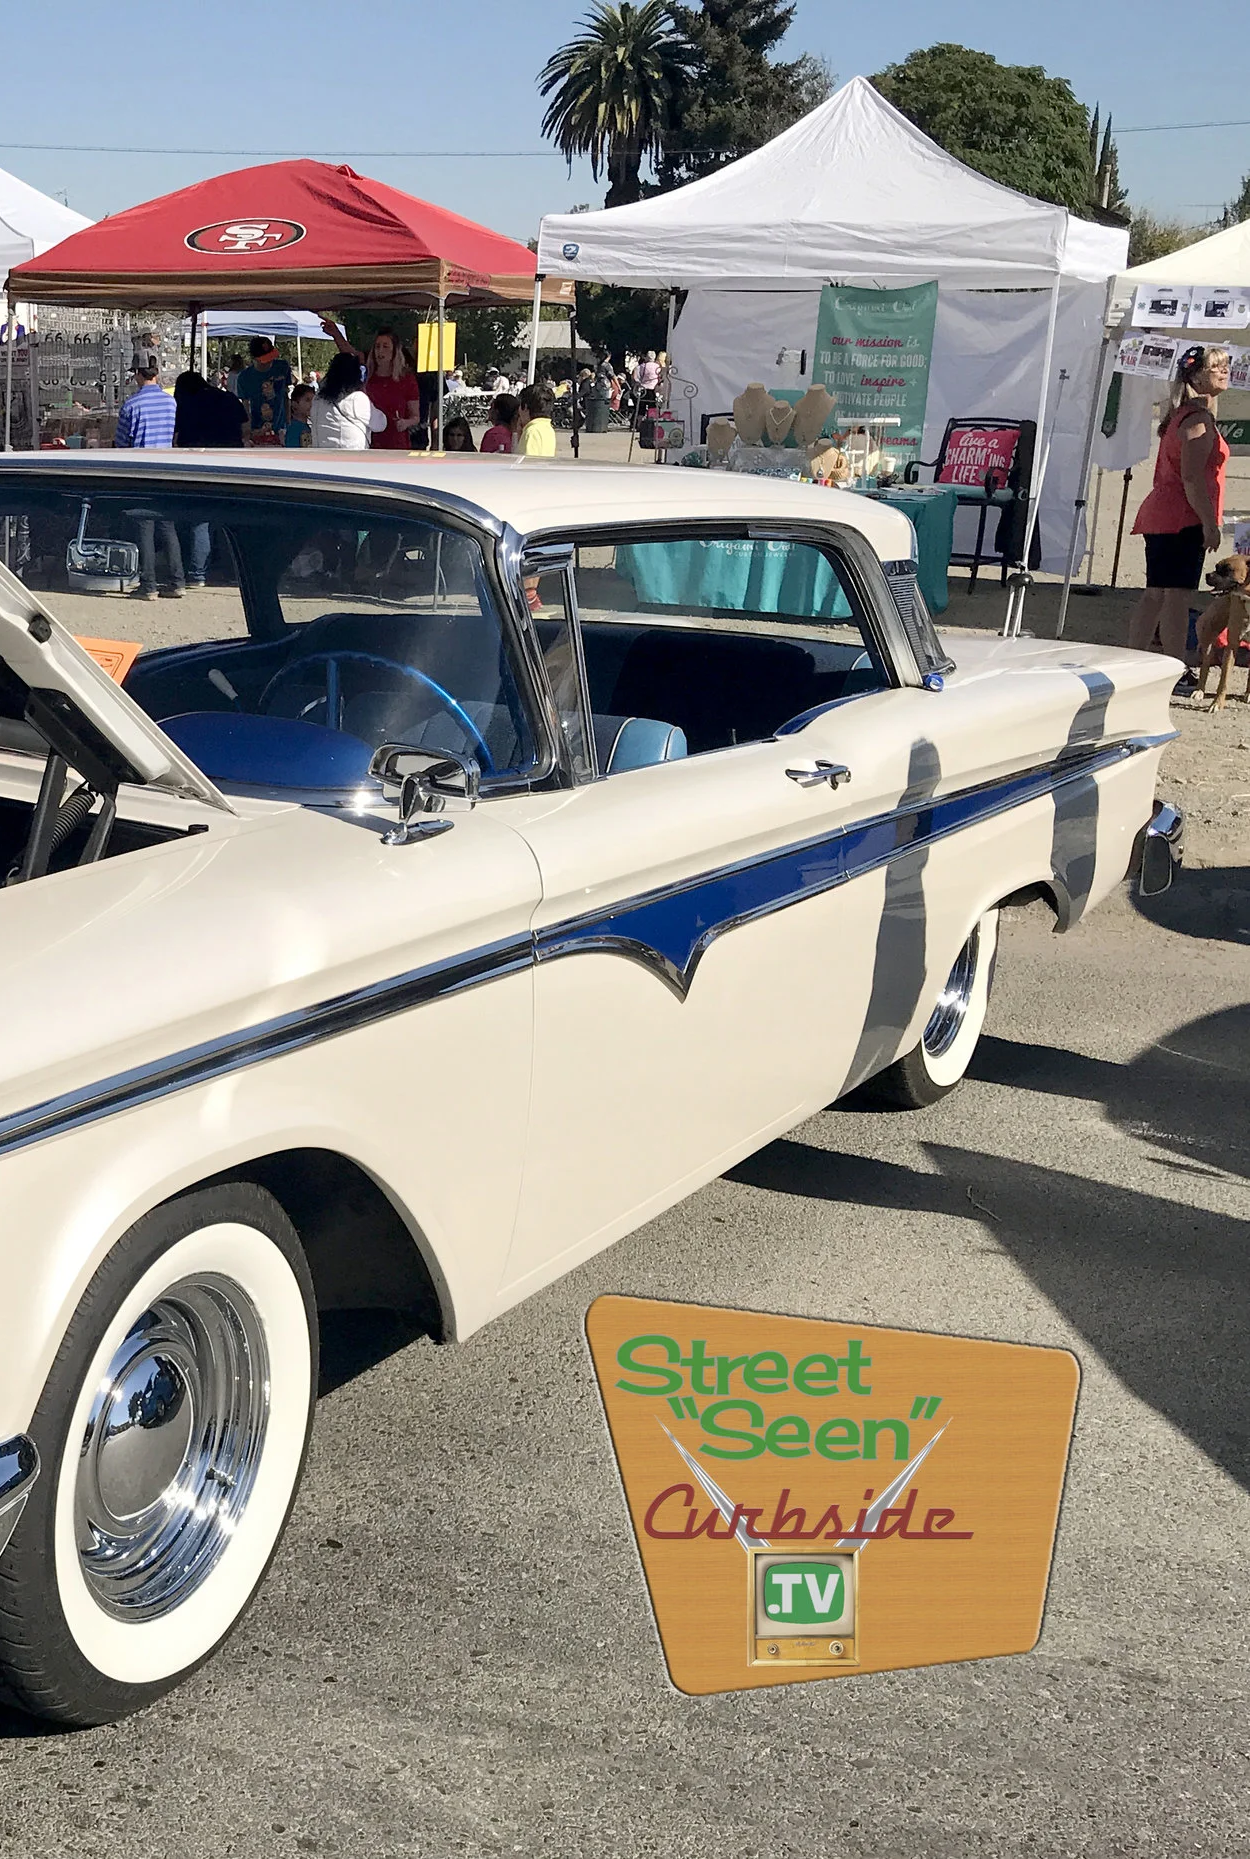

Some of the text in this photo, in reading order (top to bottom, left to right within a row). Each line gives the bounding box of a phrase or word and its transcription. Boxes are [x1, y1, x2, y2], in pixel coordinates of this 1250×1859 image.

[218, 223, 283, 250] SF
[835, 296, 886, 316] Origami
[831, 335, 920, 348] our mission is
[820, 351, 830, 365] TO
[833, 352, 842, 366] BE
[843, 353, 849, 366] A
[851, 353, 878, 368] FORCE
[880, 354, 898, 368] FOR
[824, 370, 835, 385] TO
[860, 374, 907, 393] inspire
[833, 391, 907, 407] MOTIVATE PEOPLE
[959, 431, 999, 448] live a
[951, 465, 978, 484] LIFE
